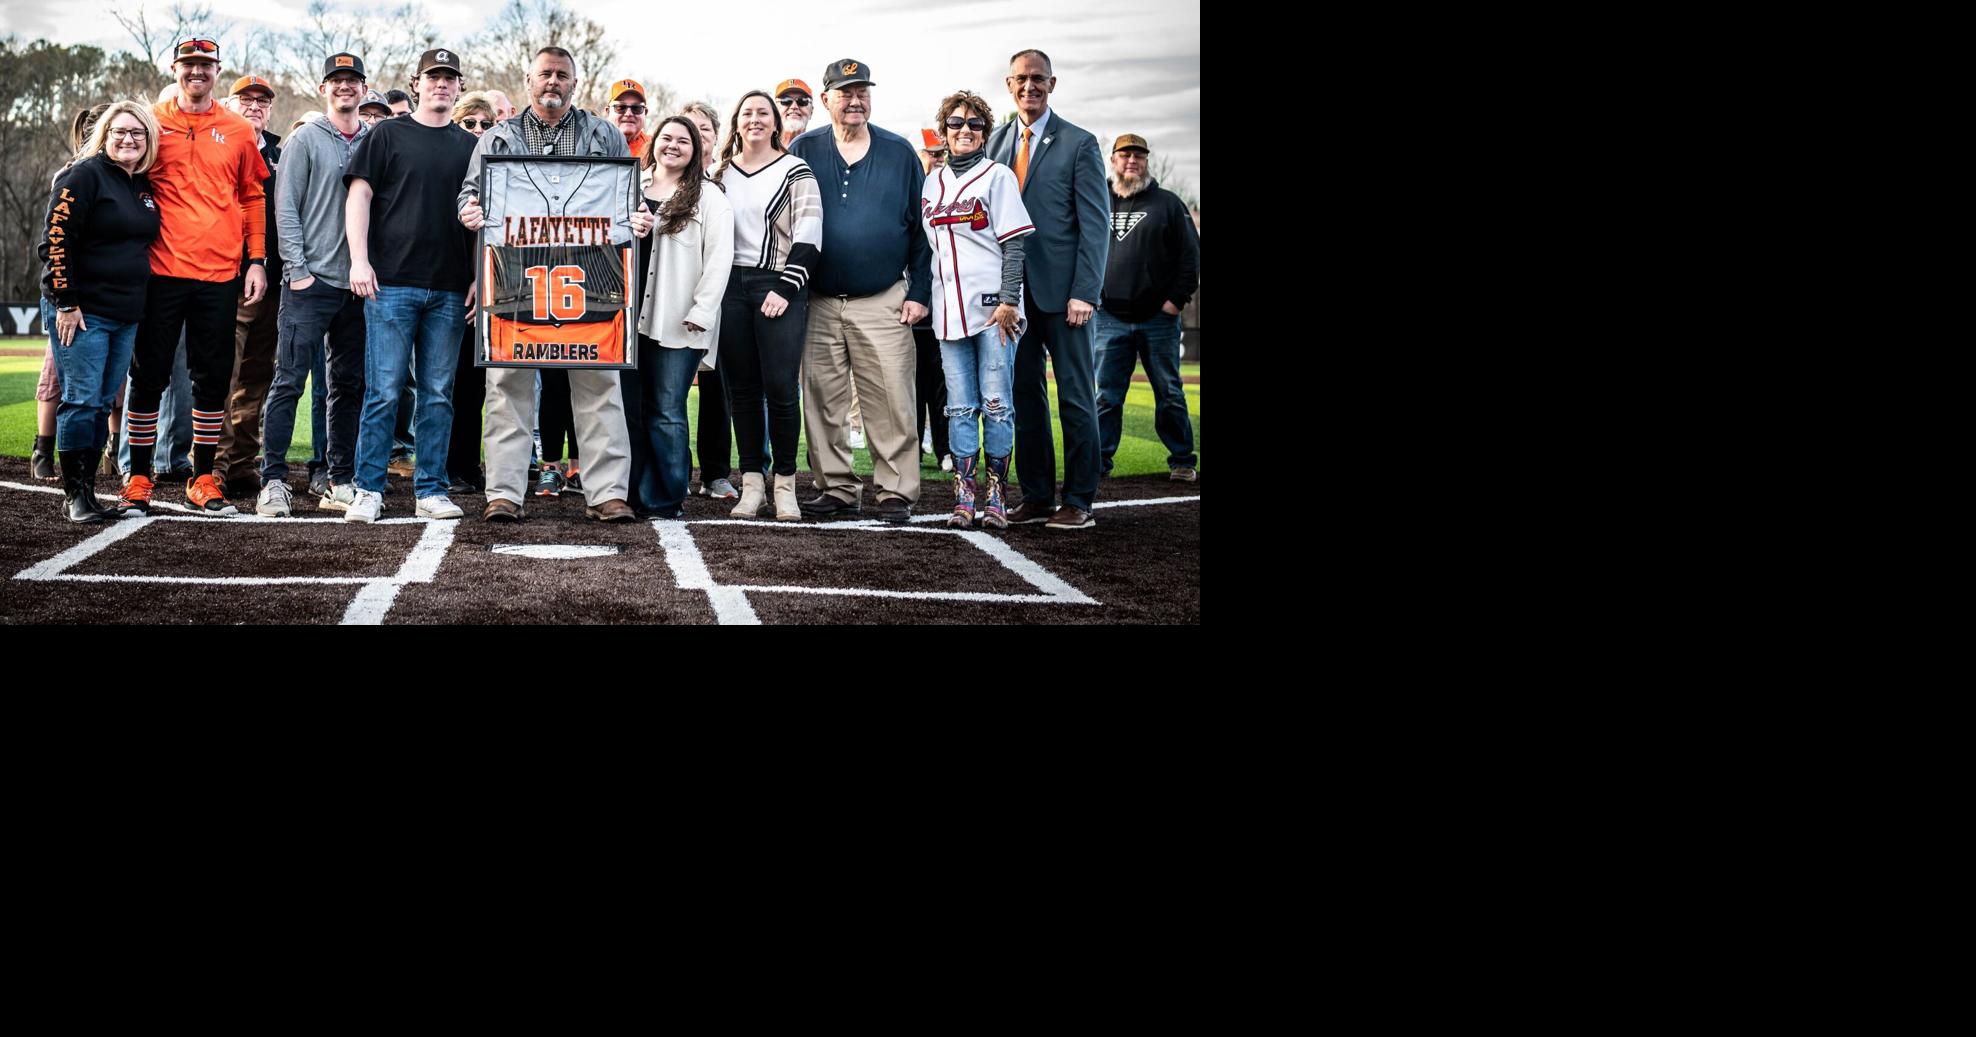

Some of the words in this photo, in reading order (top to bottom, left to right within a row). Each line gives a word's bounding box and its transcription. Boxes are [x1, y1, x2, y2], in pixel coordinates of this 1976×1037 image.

[48, 187, 75, 289] LAFAYETTE
[504, 216, 613, 247] LAFAYETTE
[525, 264, 586, 321] 16
[513, 342, 599, 361] RAMBLERS
